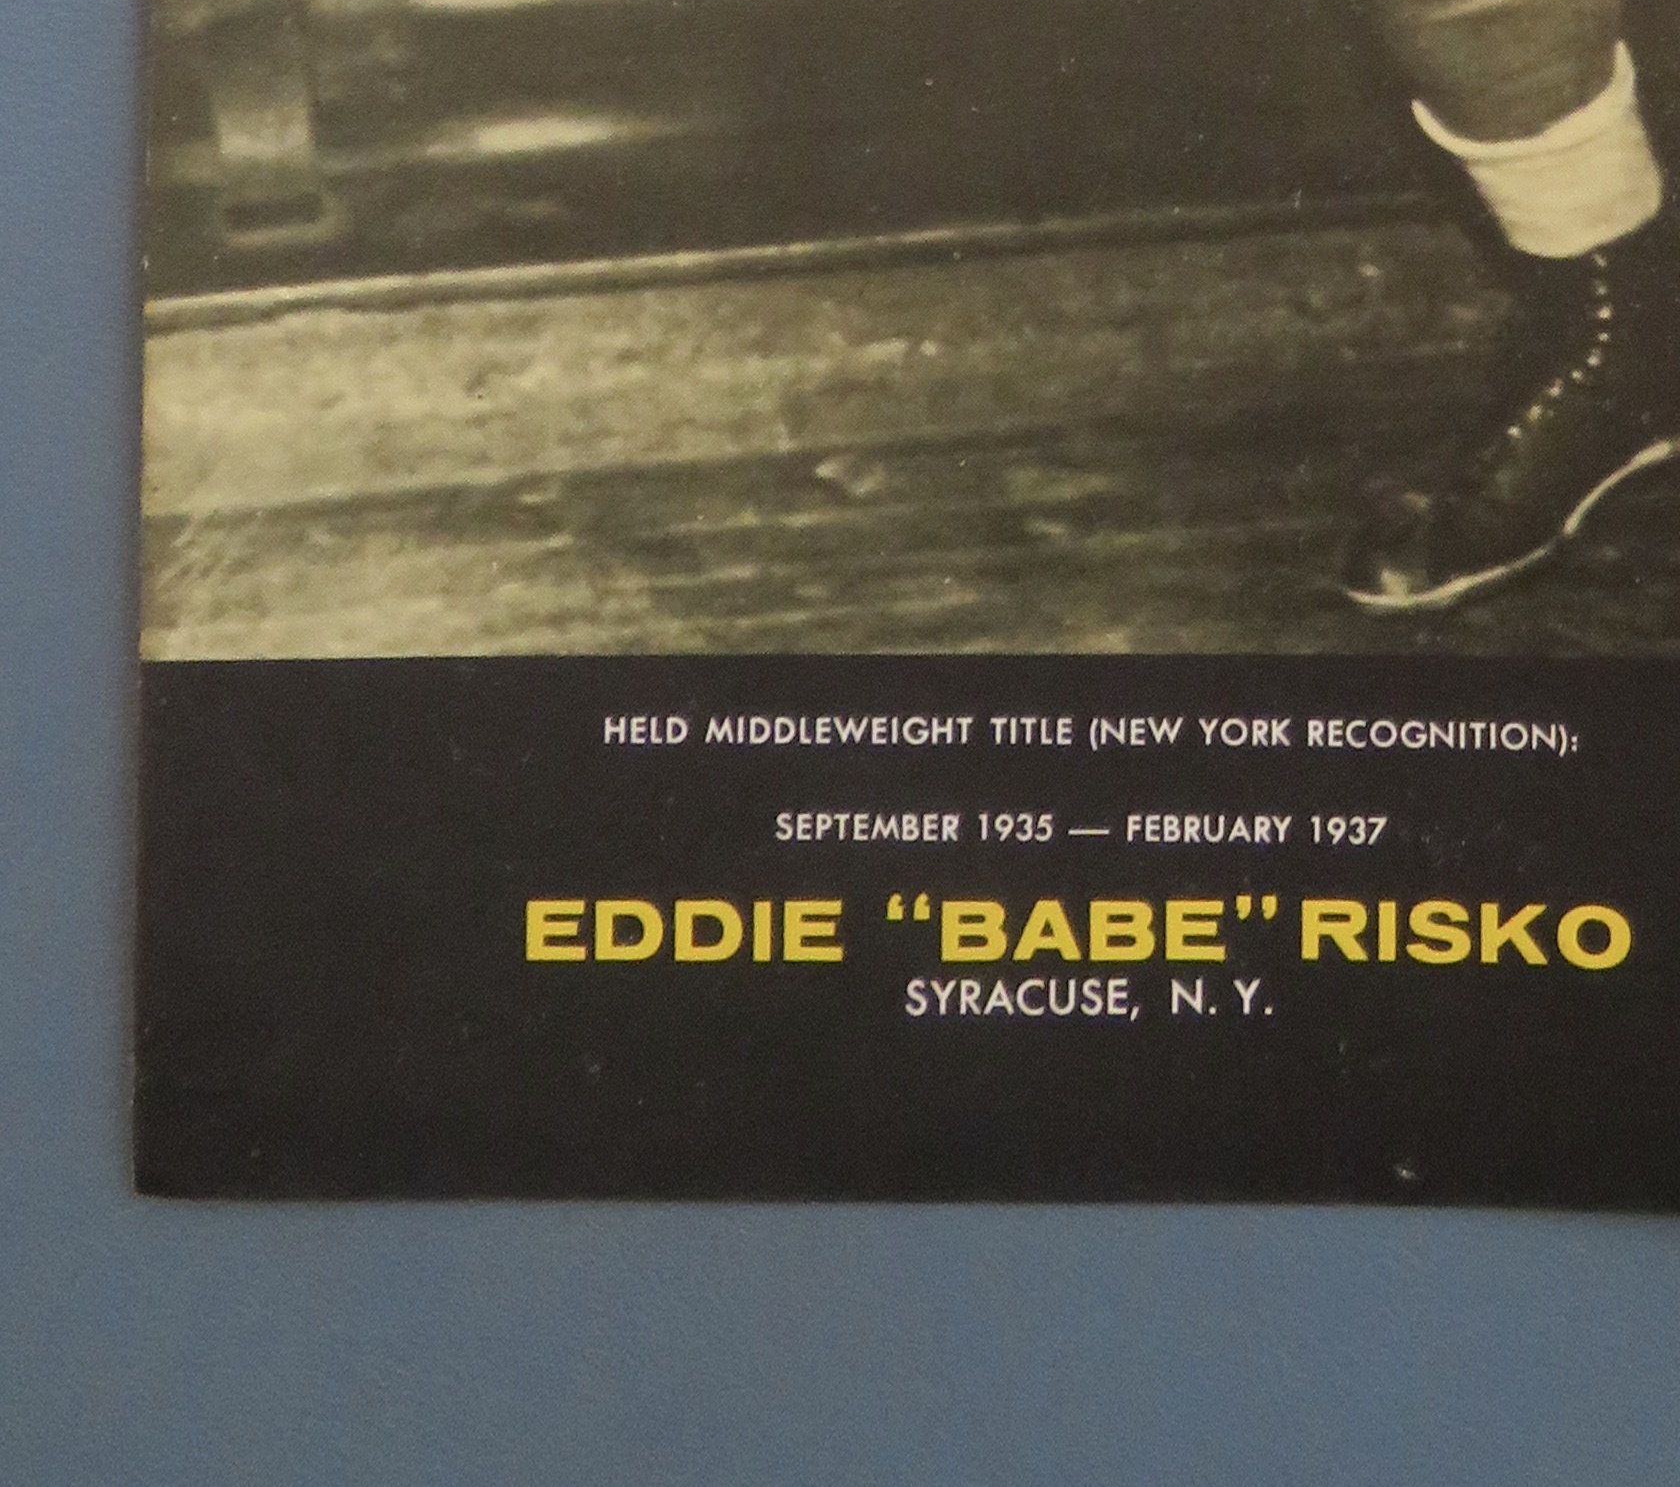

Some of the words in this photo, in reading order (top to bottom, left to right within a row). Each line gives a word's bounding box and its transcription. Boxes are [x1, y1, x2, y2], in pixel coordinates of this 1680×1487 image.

[604, 715, 689, 745] HELD
[704, 715, 974, 746] MIDDLEWEIGHT
[989, 716, 1073, 746] TITLE
[1088, 716, 1184, 751] (NEW
[1197, 716, 1291, 747] YORK
[1306, 718, 1578, 758] RECOGNITION):
[775, 811, 960, 842] SEPTEMBER
[978, 812, 1053, 842] 1935
[1126, 813, 1293, 844] FEBRUARY
[1310, 814, 1388, 845] 1937
[525, 899, 844, 962] EDDIE
[1300, 899, 1632, 970] RISKO
[905, 977, 1140, 1023] SYRACUSE,
[1171, 977, 1217, 1016] N.
[1233, 977, 1273, 1016] Y.
